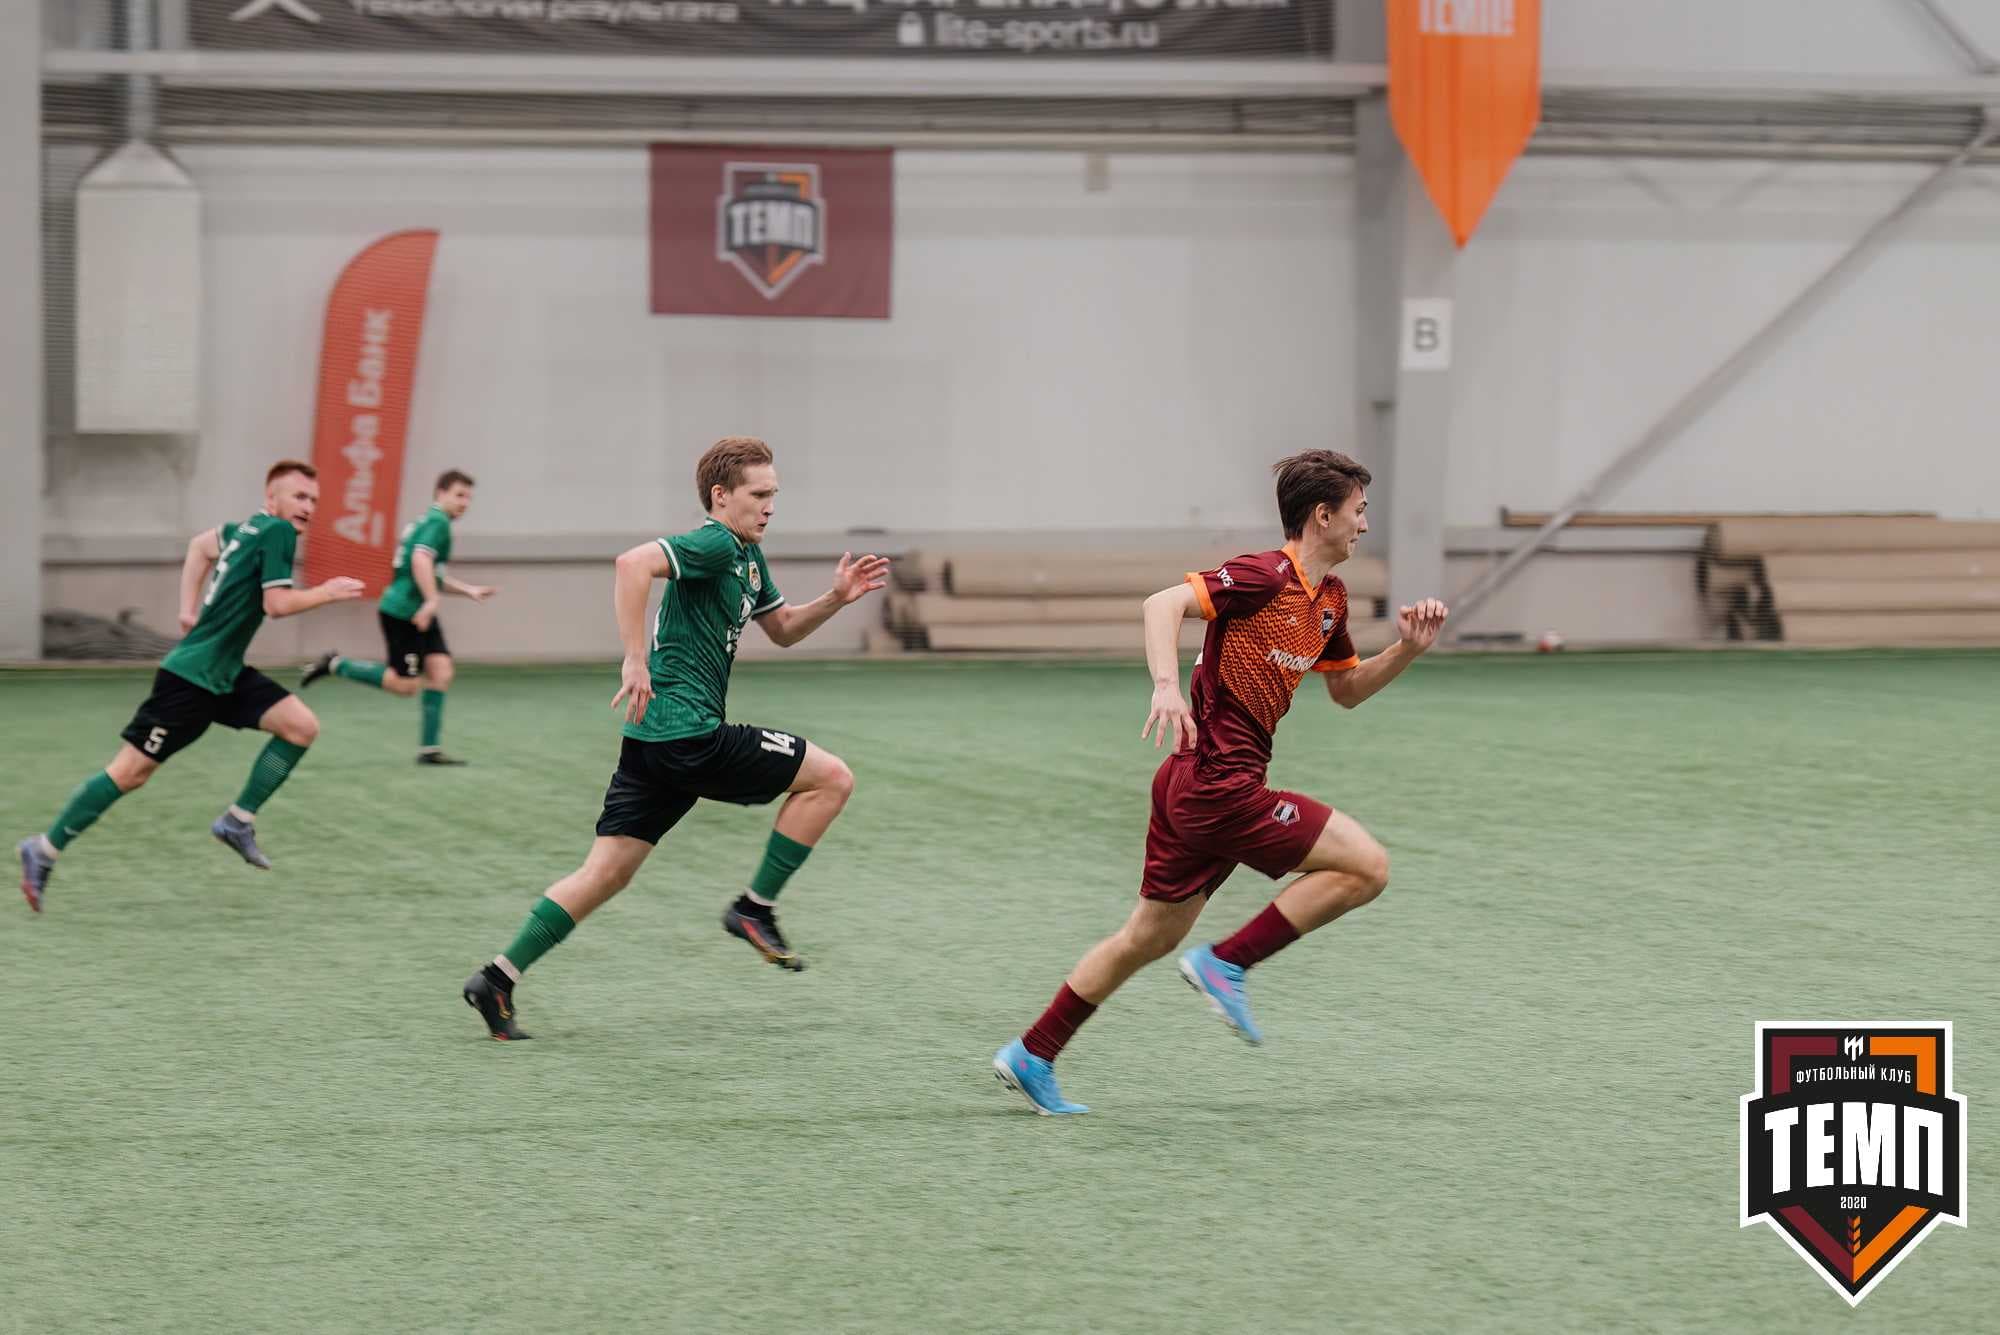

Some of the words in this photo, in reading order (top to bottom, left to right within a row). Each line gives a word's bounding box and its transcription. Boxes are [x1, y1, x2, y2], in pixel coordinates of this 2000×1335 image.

[935, 14, 1159, 51] lite-sports.ru
[731, 200, 815, 249] ТЕМП
[347, 308, 392, 407] Банк
[333, 414, 385, 545] Альфа
[144, 726, 168, 754] 5
[761, 729, 796, 757] 14
